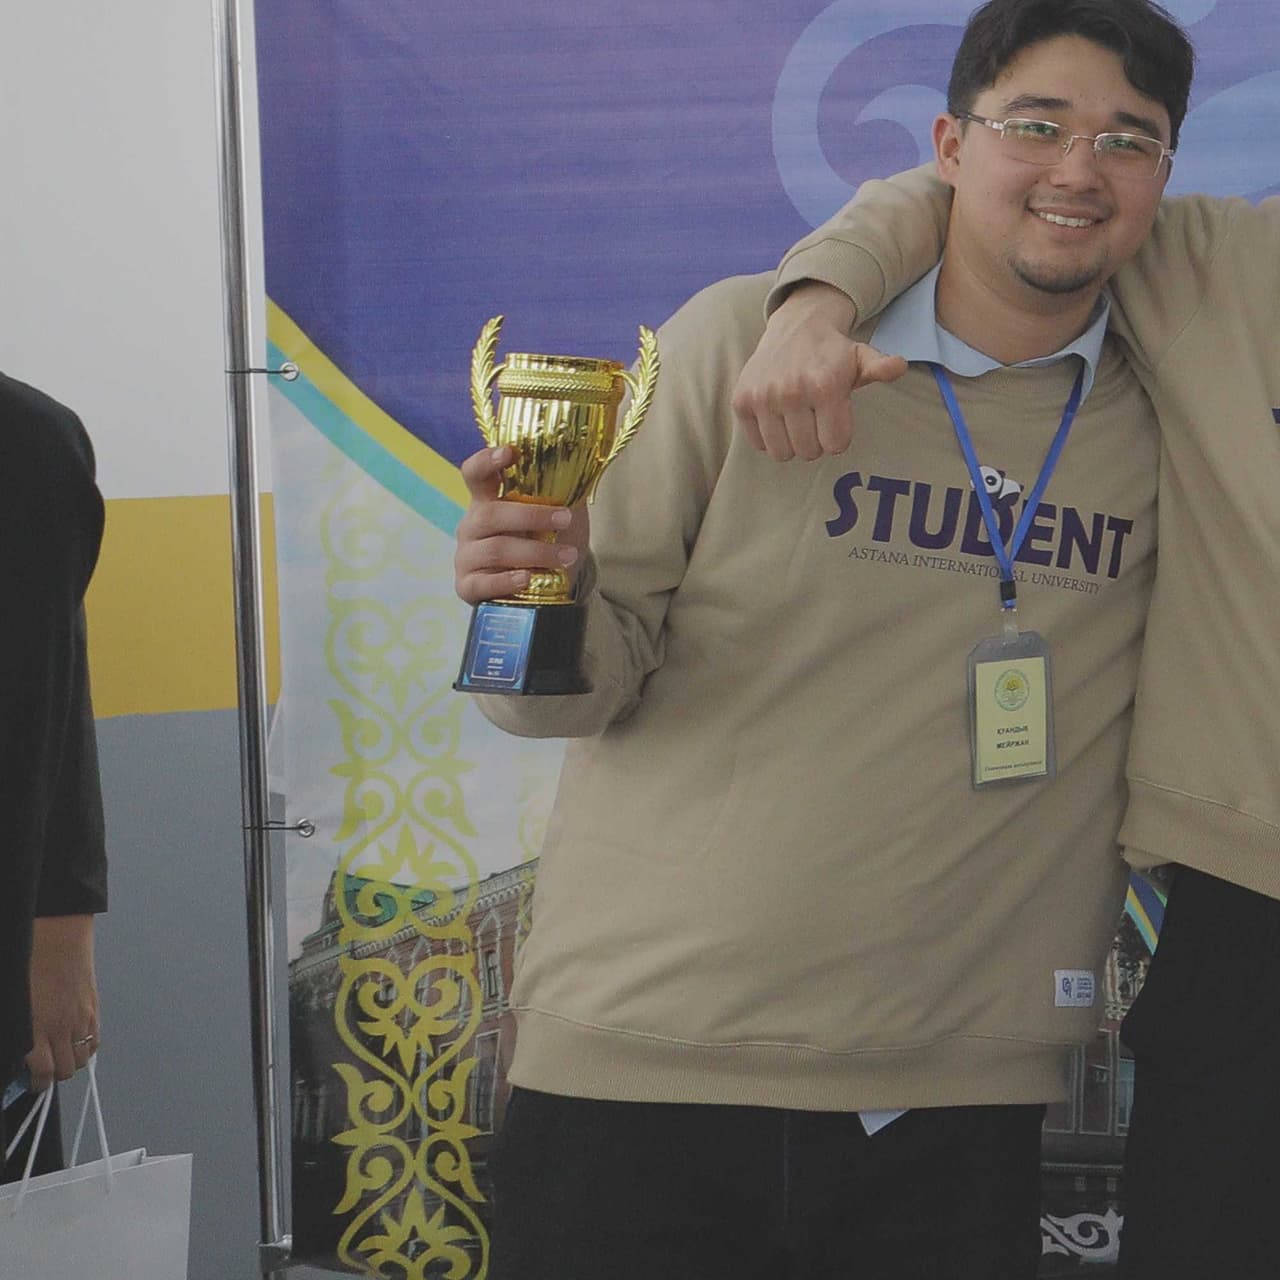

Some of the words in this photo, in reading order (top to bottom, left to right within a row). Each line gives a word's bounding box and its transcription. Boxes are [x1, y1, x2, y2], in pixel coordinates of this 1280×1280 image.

[825, 471, 1134, 580] STUDENT
[848, 546, 910, 567] ASTANA
[912, 554, 1029, 584] INTERNATIOAL
[1031, 573, 1103, 596] UNIVERSITY
